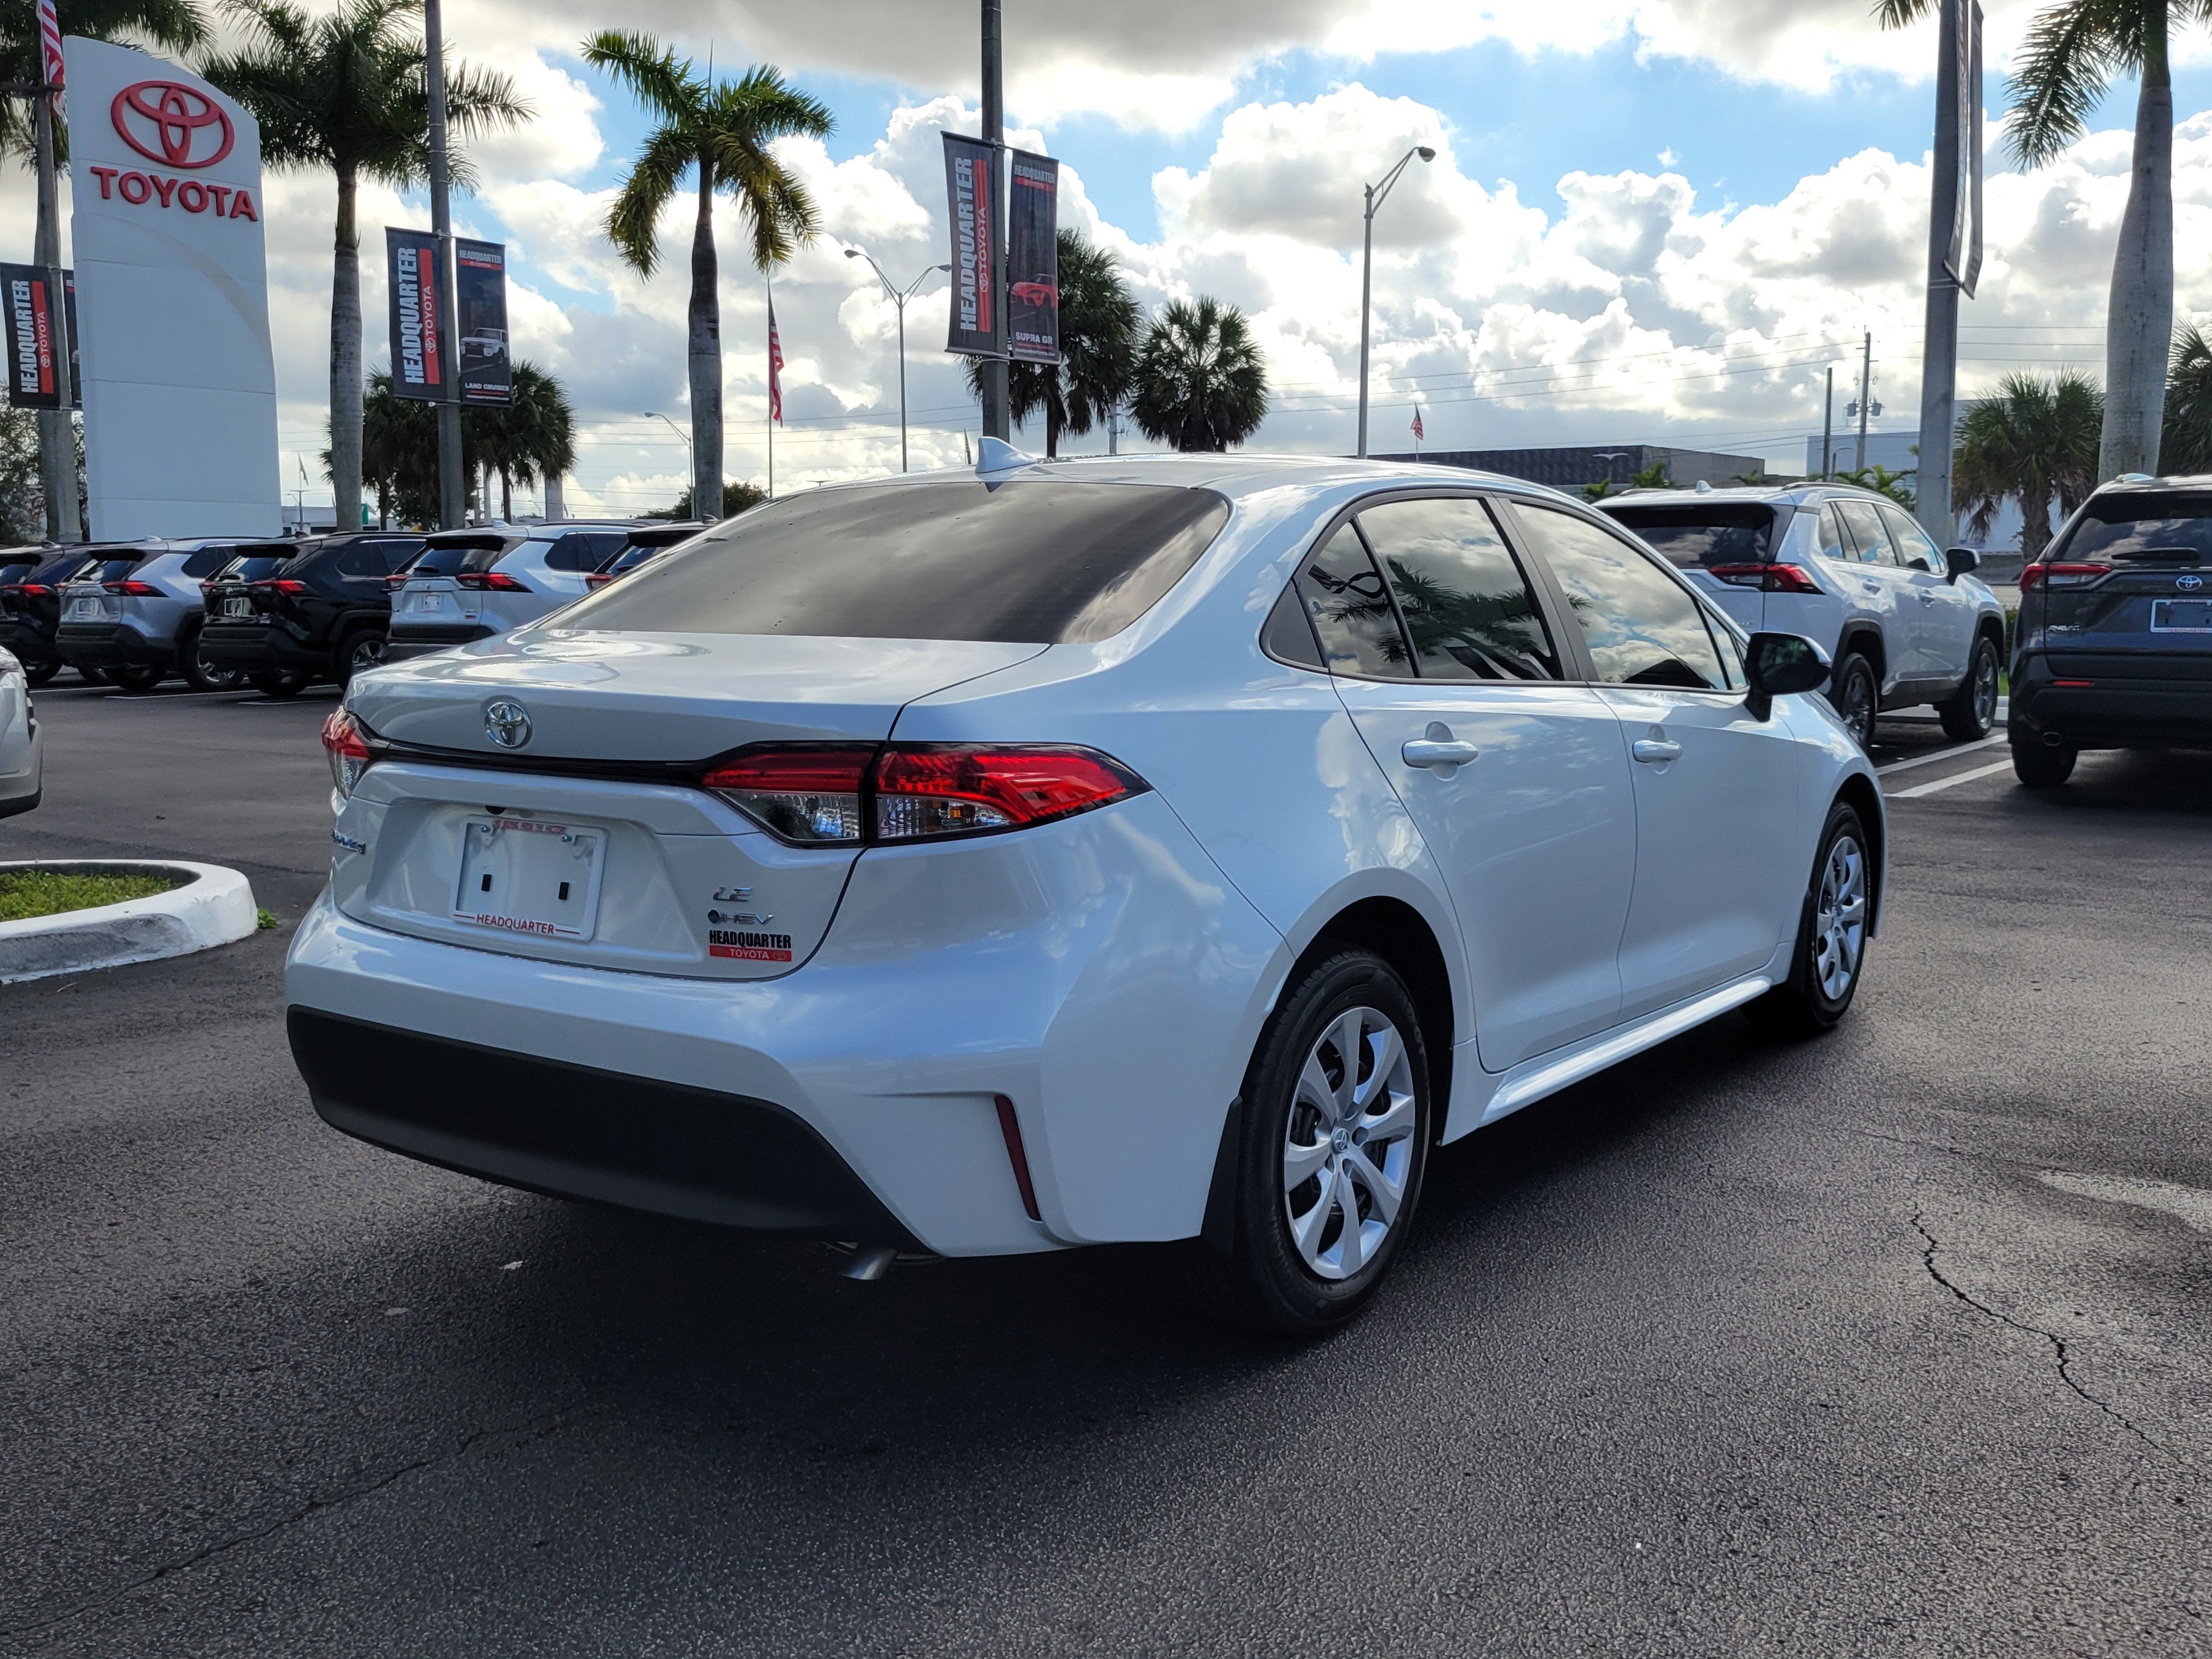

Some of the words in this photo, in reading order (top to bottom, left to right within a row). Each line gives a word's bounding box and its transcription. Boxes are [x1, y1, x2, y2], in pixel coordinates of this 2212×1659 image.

[91, 166, 258, 222] TOYOTA
[955, 157, 977, 331] HEADQUARTER
[978, 207, 987, 269] TOYOTA
[398, 247, 425, 384] HEADQUARTER
[424, 286, 434, 336] TOYOTA
[12, 280, 39, 393] HEADQUARTER
[37, 312, 49, 353] TOYOTA
[1015, 331, 1041, 343] SUPRA
[1042, 335, 1053, 345] GR
[483, 383, 510, 392] CRUISER
[713, 887, 753, 902] LE
[476, 913, 555, 935] HEADQUARTER
[709, 929, 792, 949] HEADQUARTER
[730, 948, 770, 960] TOYOTA
